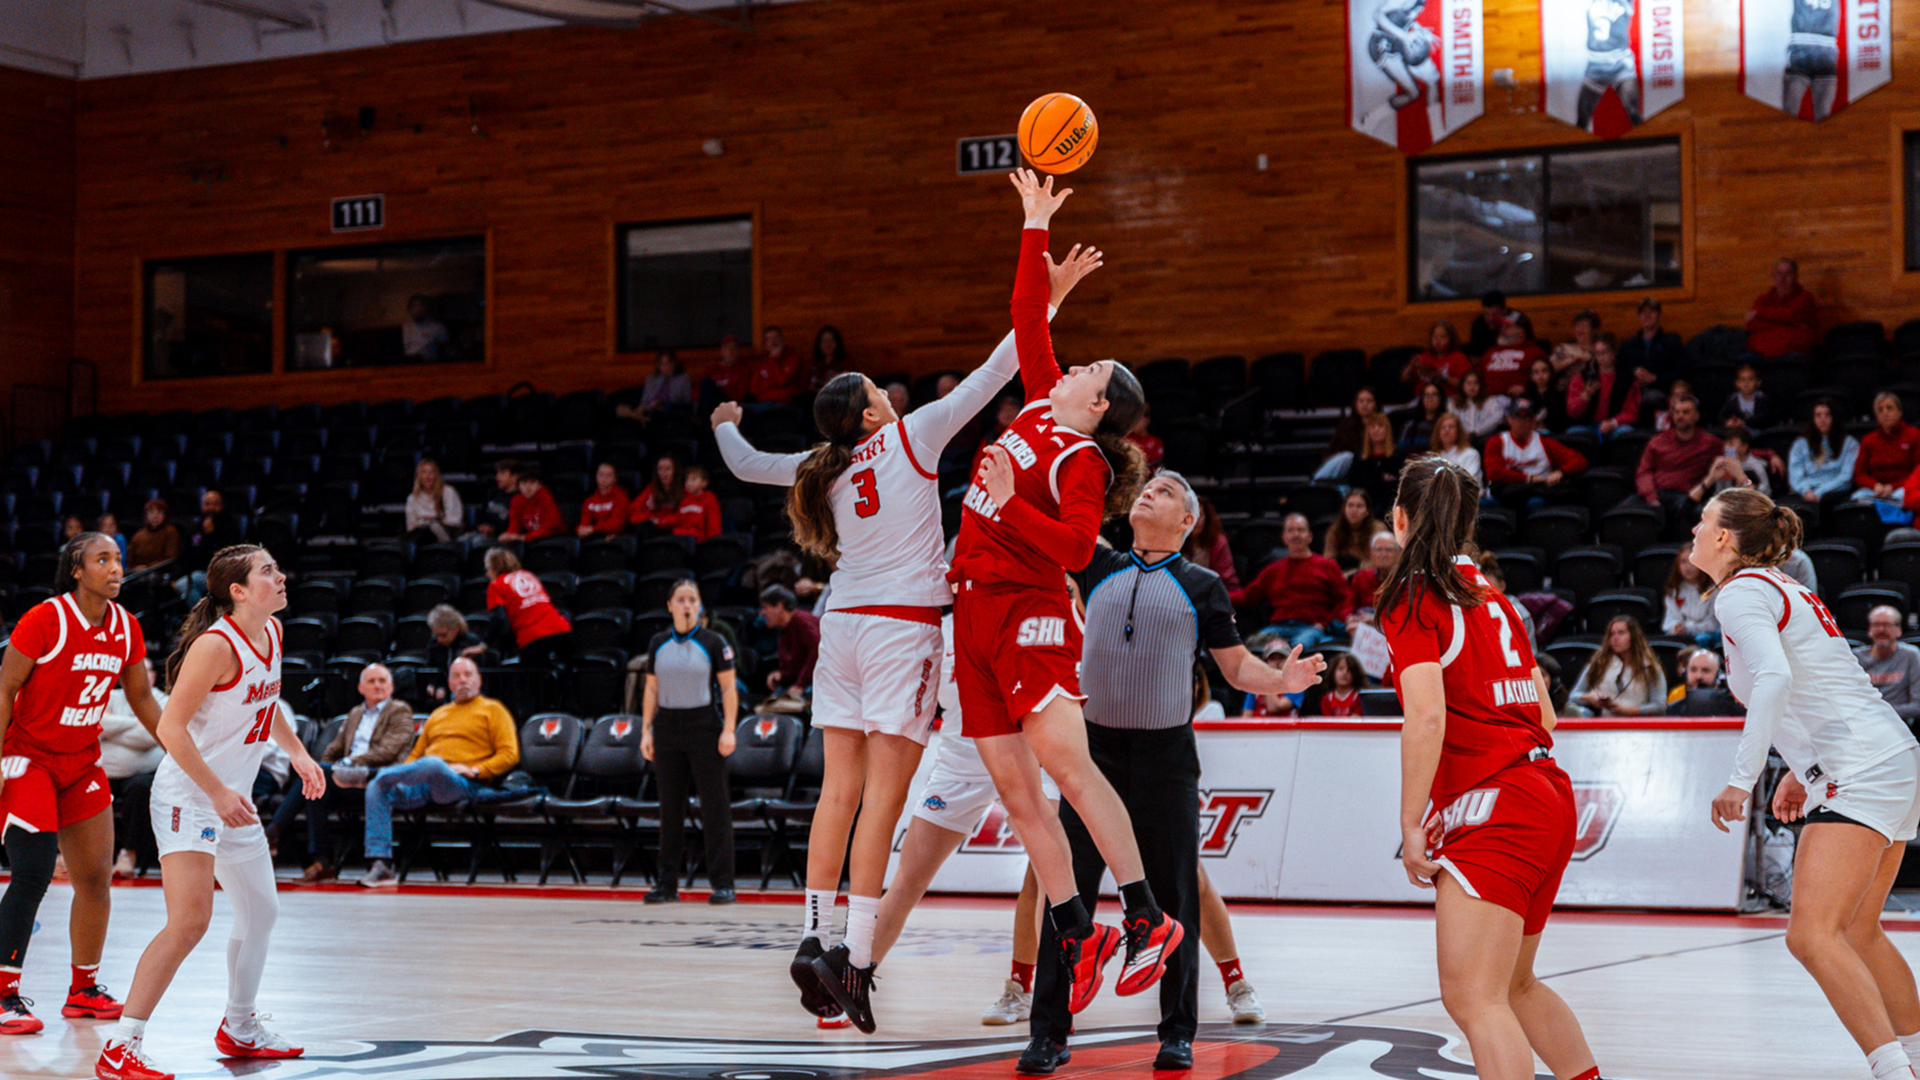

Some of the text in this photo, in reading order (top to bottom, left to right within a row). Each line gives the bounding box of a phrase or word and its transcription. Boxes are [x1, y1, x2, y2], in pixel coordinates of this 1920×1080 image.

[1453, 8, 1474, 77] SMITH
[1652, 6, 1673, 61] DAVIS
[968, 139, 1013, 169] 112
[1054, 113, 1093, 156] Wilson
[340, 200, 376, 226] 111
[996, 429, 1037, 471] SACRED
[851, 467, 881, 519] 3
[1016, 616, 1067, 647] SHU
[1487, 601, 1522, 668] 2
[71, 652, 123, 675] SACRED
[78, 675, 112, 705] 24
[243, 701, 277, 745] 21
